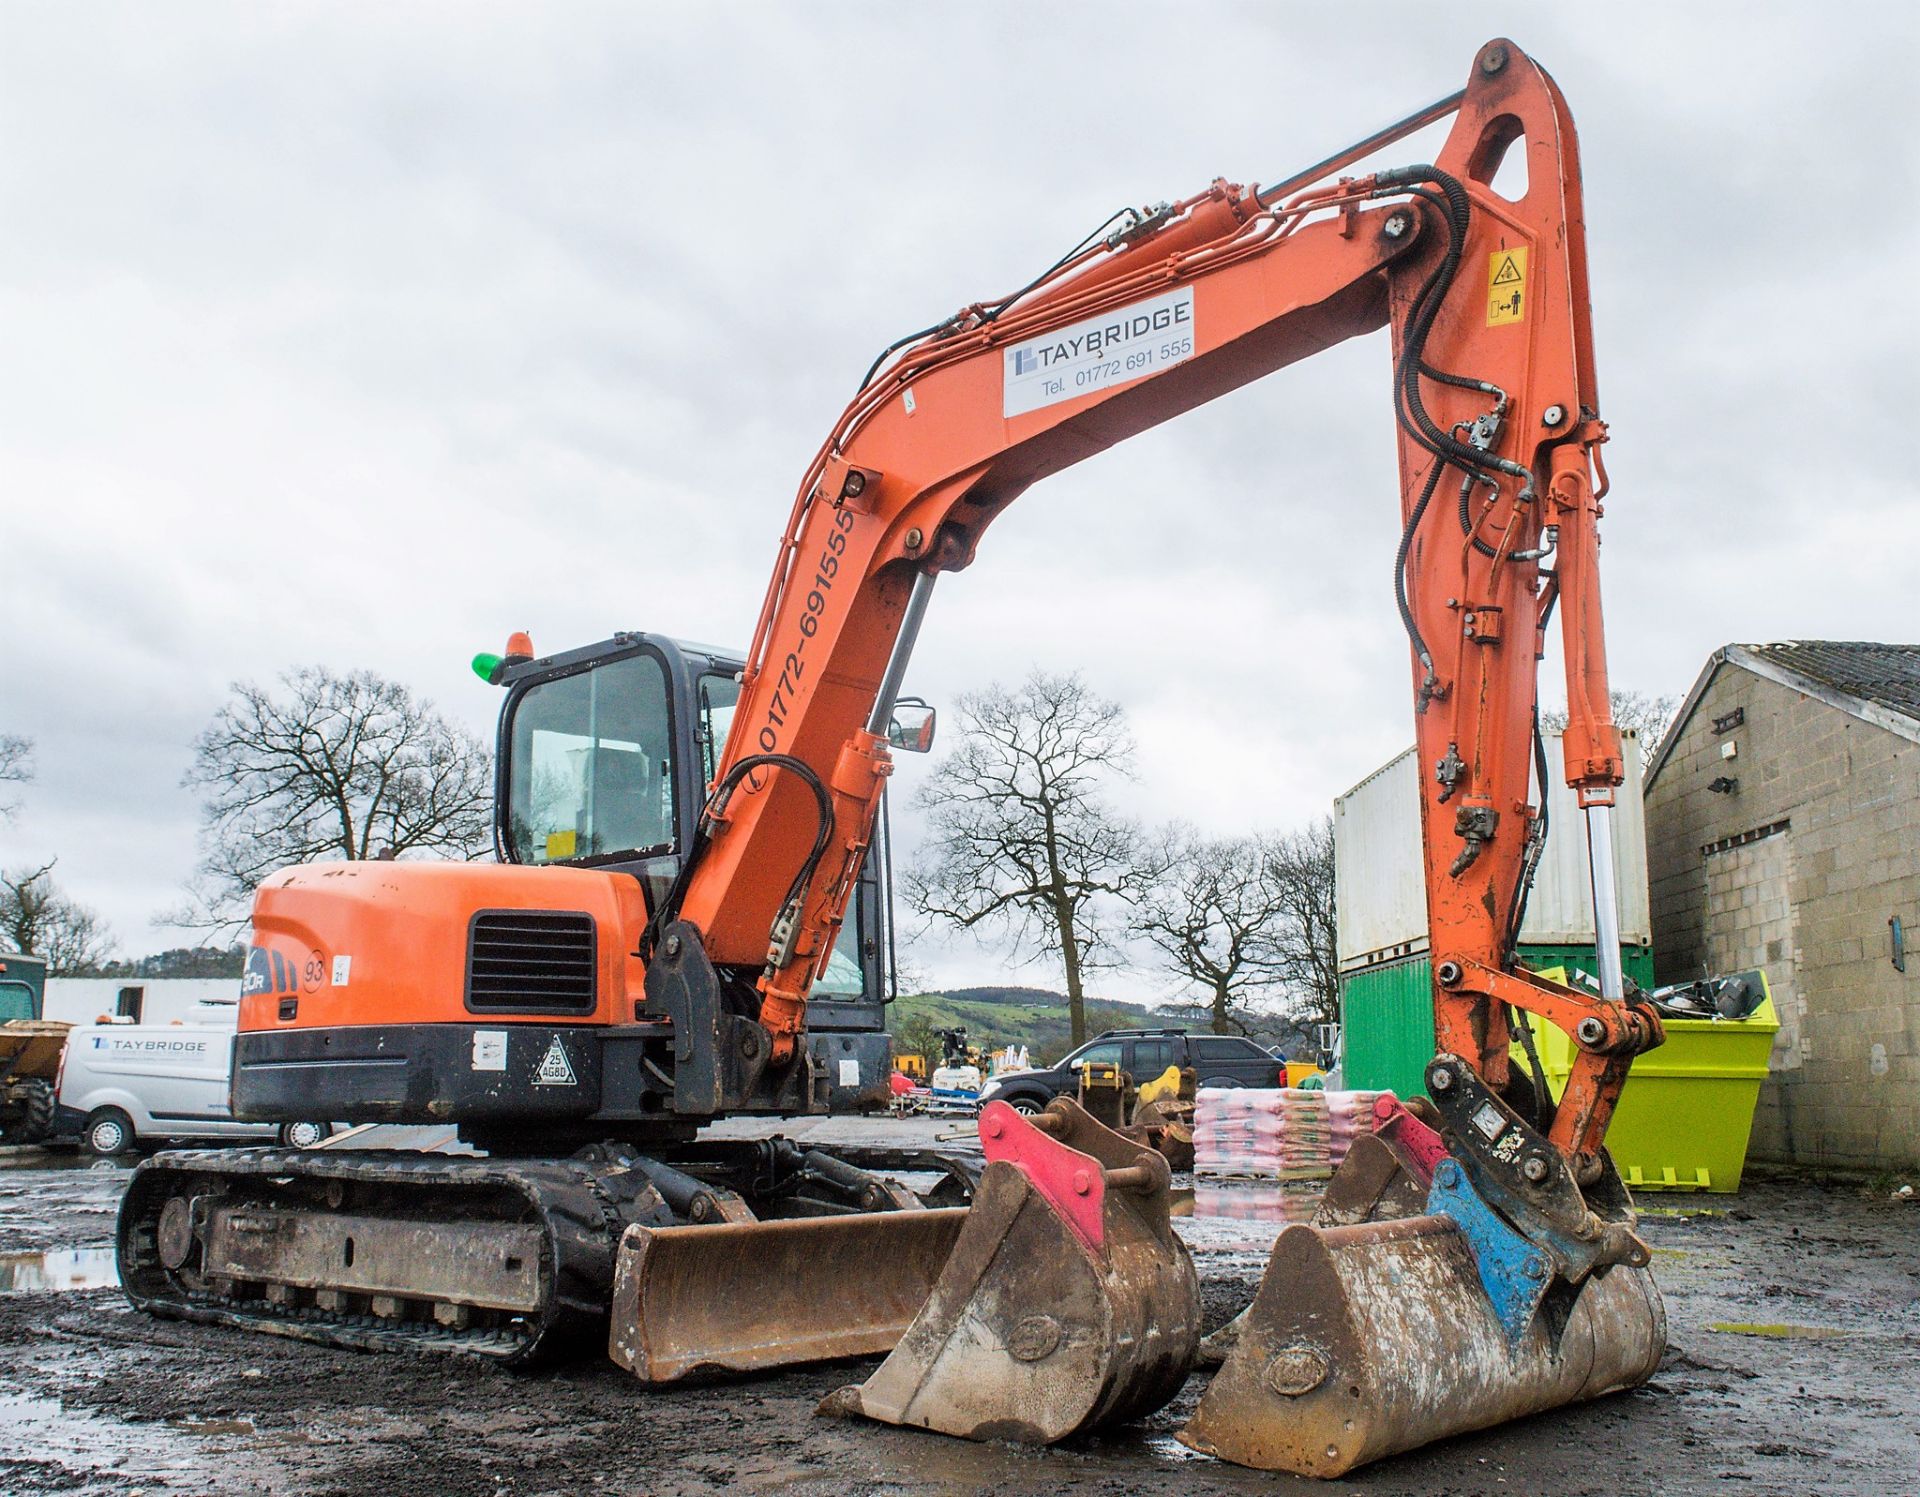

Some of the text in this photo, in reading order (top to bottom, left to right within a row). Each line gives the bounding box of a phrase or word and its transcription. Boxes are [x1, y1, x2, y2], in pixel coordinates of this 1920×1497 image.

[1038, 301, 1190, 366] TAYBRIDGE
[1042, 338, 1191, 396] Tel. 01772 691 555
[758, 507, 855, 753] 01772-691555
[305, 960, 324, 982] 93
[114, 1040, 207, 1051] TAYBRIDGE
[549, 1054, 561, 1065] 25
